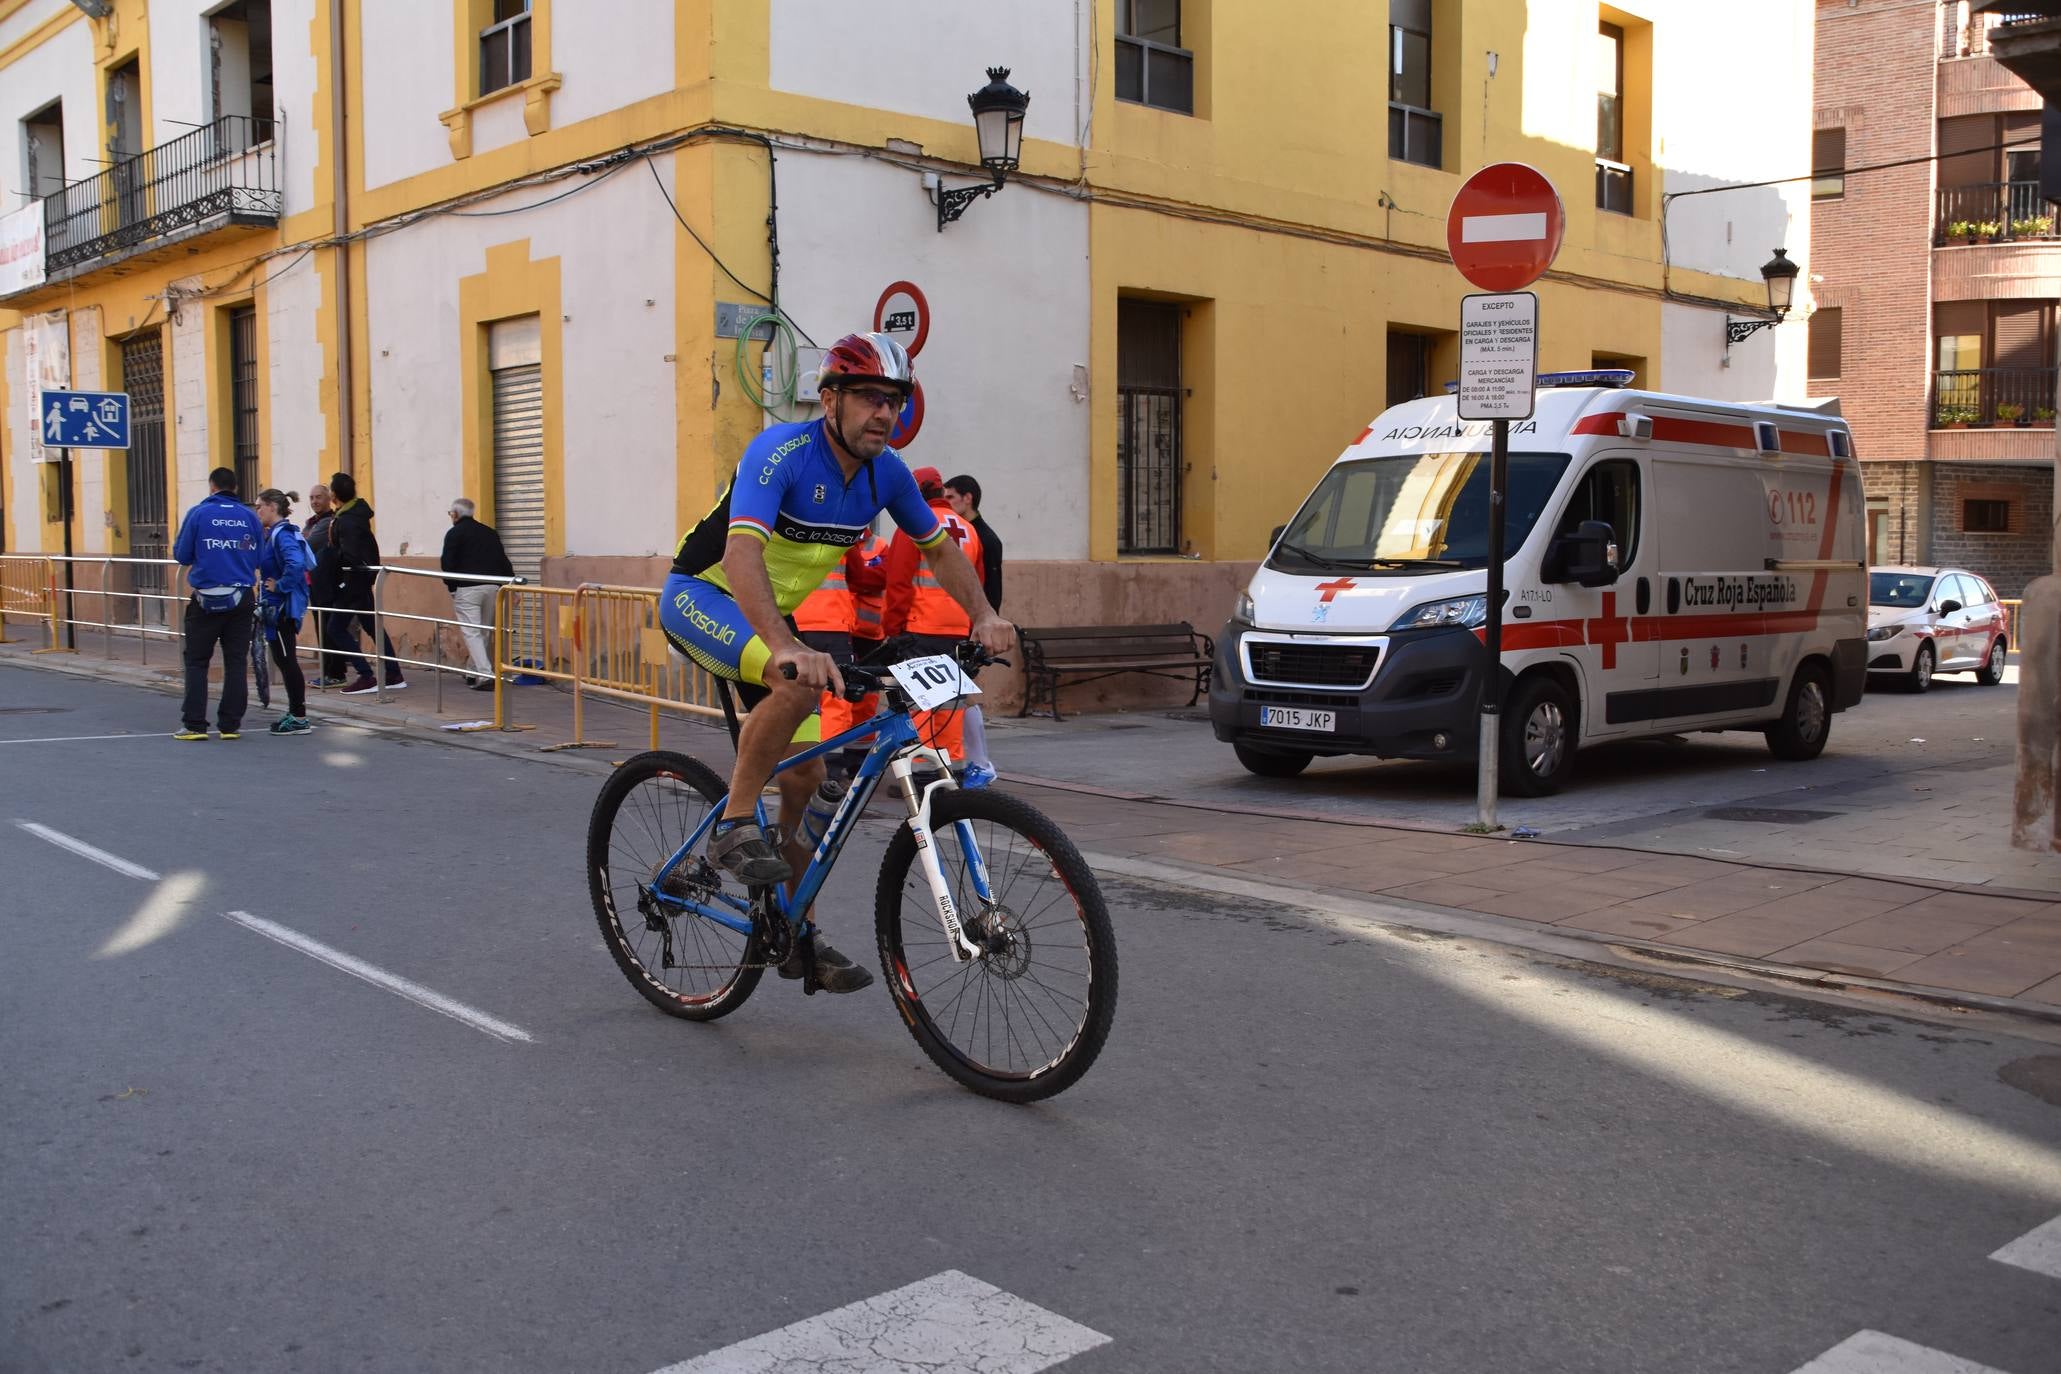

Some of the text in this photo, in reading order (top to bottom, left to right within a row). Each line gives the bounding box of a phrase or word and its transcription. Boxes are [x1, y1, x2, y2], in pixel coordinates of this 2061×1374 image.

[1482, 302, 1514, 310] EXCEPTO
[1464, 329, 1492, 337] OFICIALES
[1500, 336, 1531, 344] DESCARGA
[777, 433, 811, 457] bascula
[1788, 491, 1816, 525] 112
[212, 519, 248, 528] OFICIAL
[808, 530, 822, 540] la
[1685, 576, 1796, 612] Cruz Roja Española
[682, 600, 736, 646] bascula
[910, 664, 956, 690] 107
[1269, 708, 1331, 729] 7015 JKP
